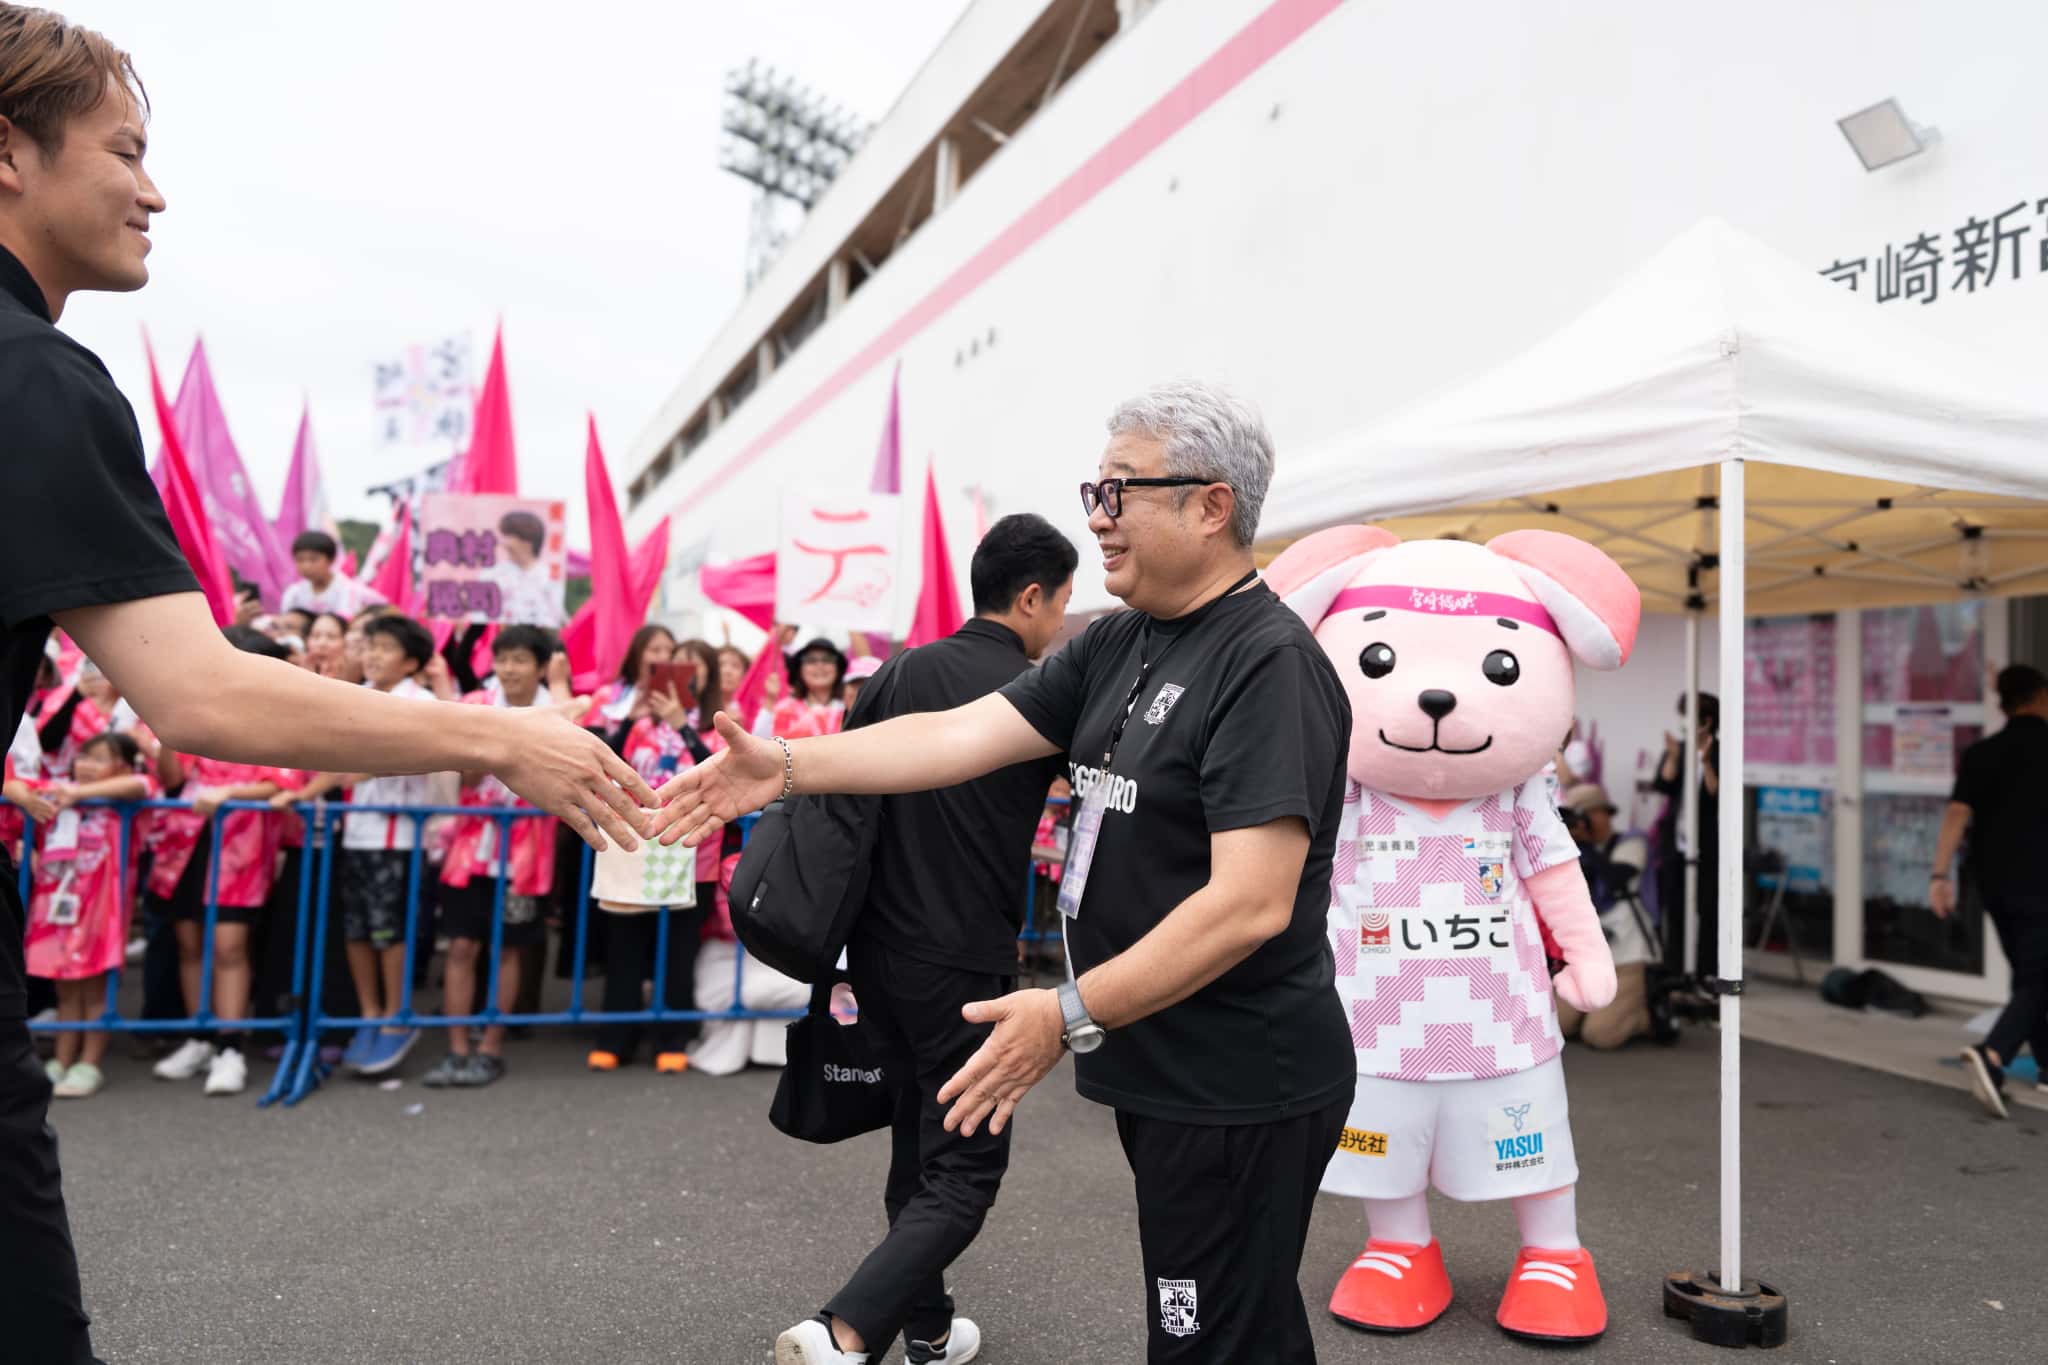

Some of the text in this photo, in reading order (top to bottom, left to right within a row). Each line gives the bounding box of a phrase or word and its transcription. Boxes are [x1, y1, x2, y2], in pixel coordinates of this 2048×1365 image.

[1401, 909, 1510, 951] いちご
[1495, 1132, 1543, 1161] YASUI
